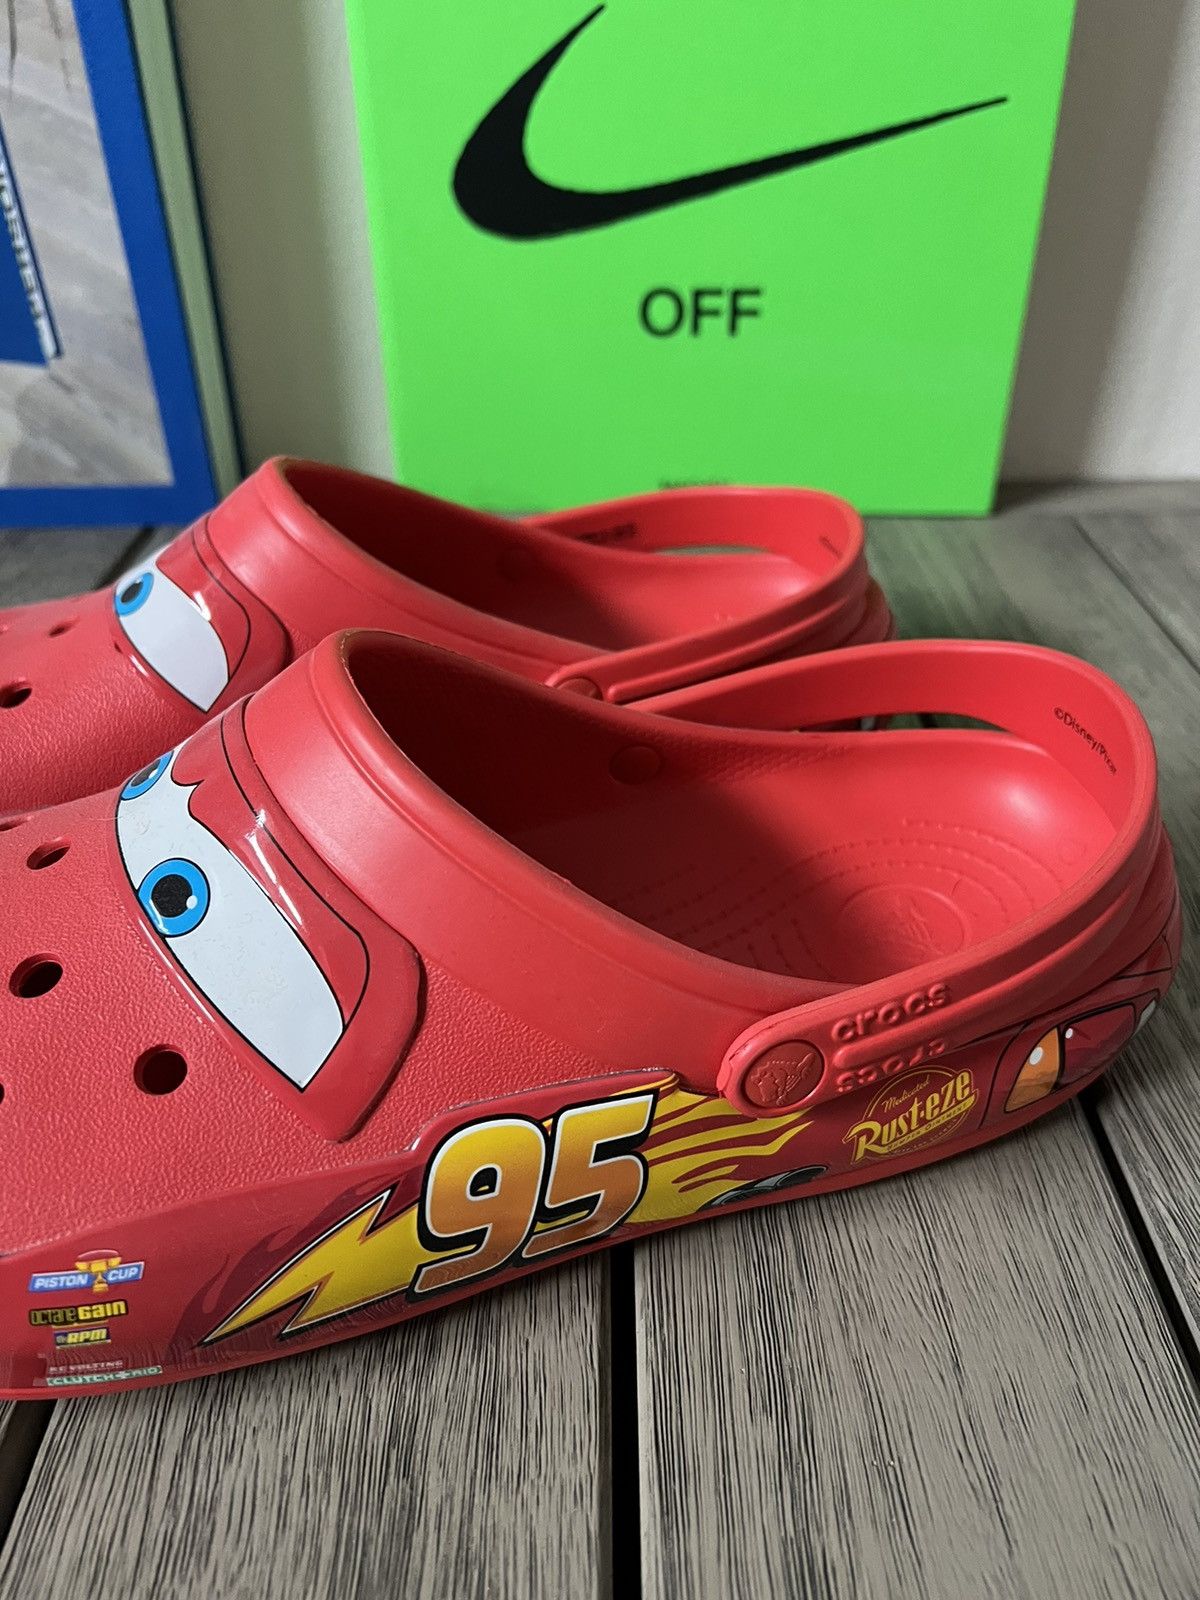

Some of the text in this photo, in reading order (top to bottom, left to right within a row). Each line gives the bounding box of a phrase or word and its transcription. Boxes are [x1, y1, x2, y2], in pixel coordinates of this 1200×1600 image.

[640, 287, 762, 337] OFF
[832, 983, 948, 1042] crocs
[405, 1088, 658, 1303] 95
[34, 1267, 139, 1289] PISTON CUP
